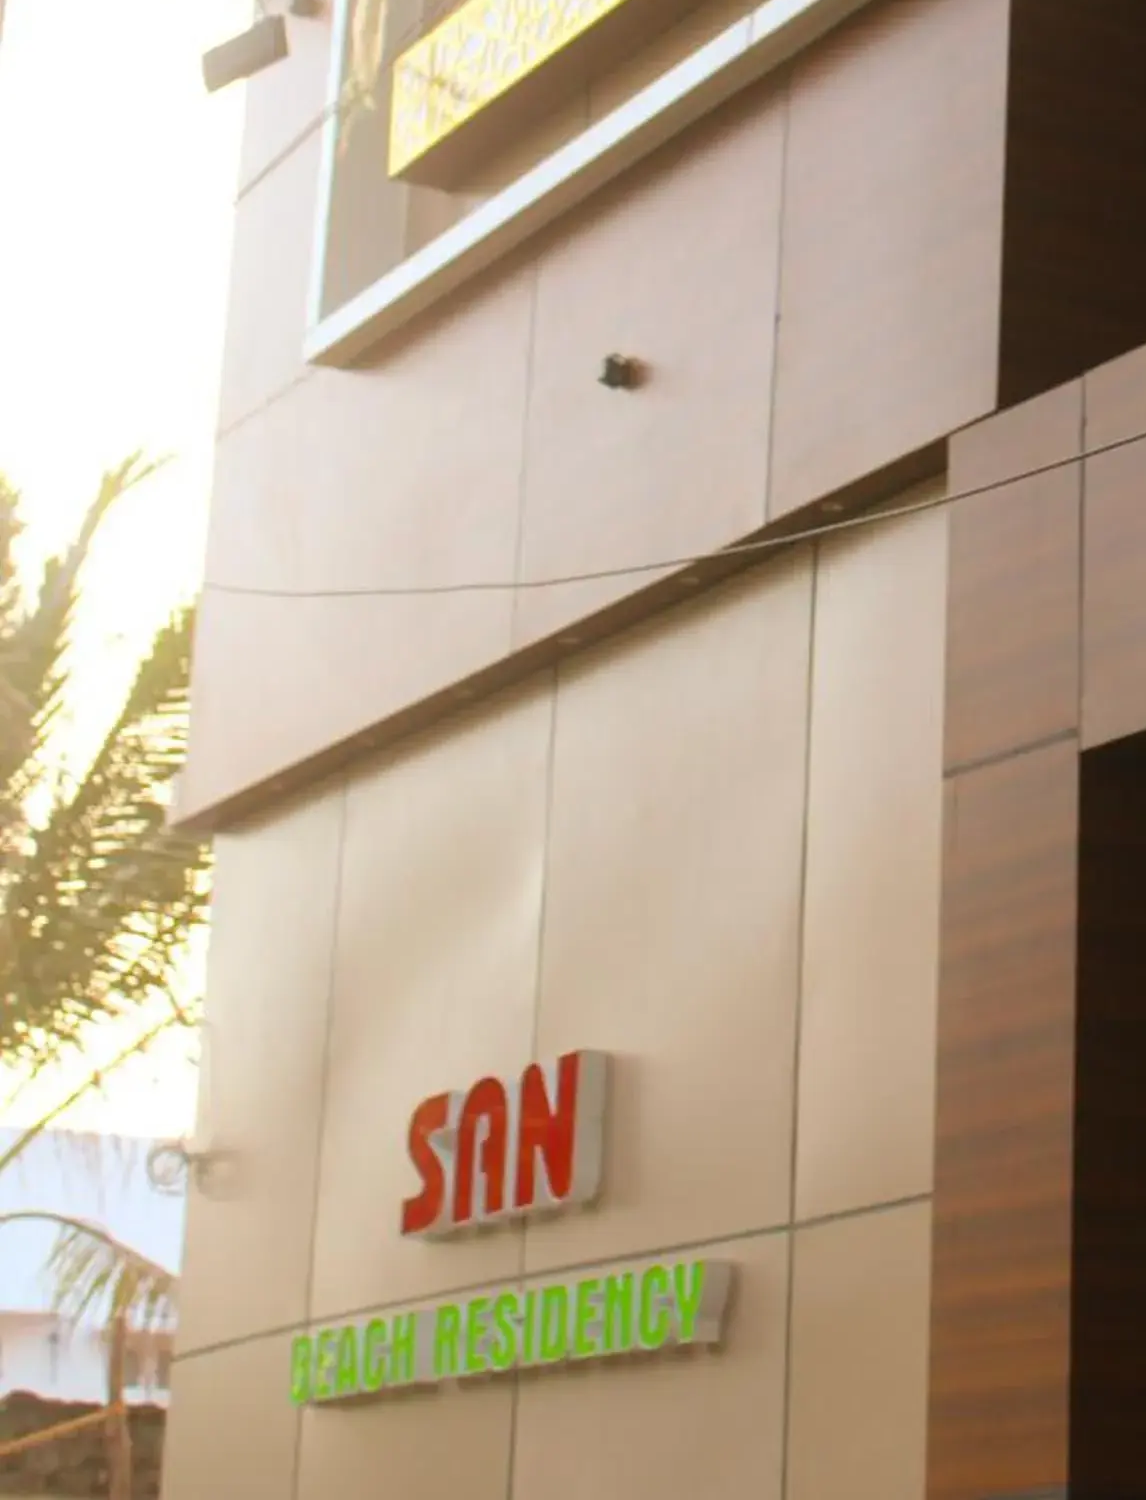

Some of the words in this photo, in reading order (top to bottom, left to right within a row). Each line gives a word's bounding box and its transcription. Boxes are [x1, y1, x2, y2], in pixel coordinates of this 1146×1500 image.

[401, 1050, 582, 1235] SAN
[290, 1311, 417, 1405] BEACH
[433, 1259, 706, 1373] RESIDENCY
